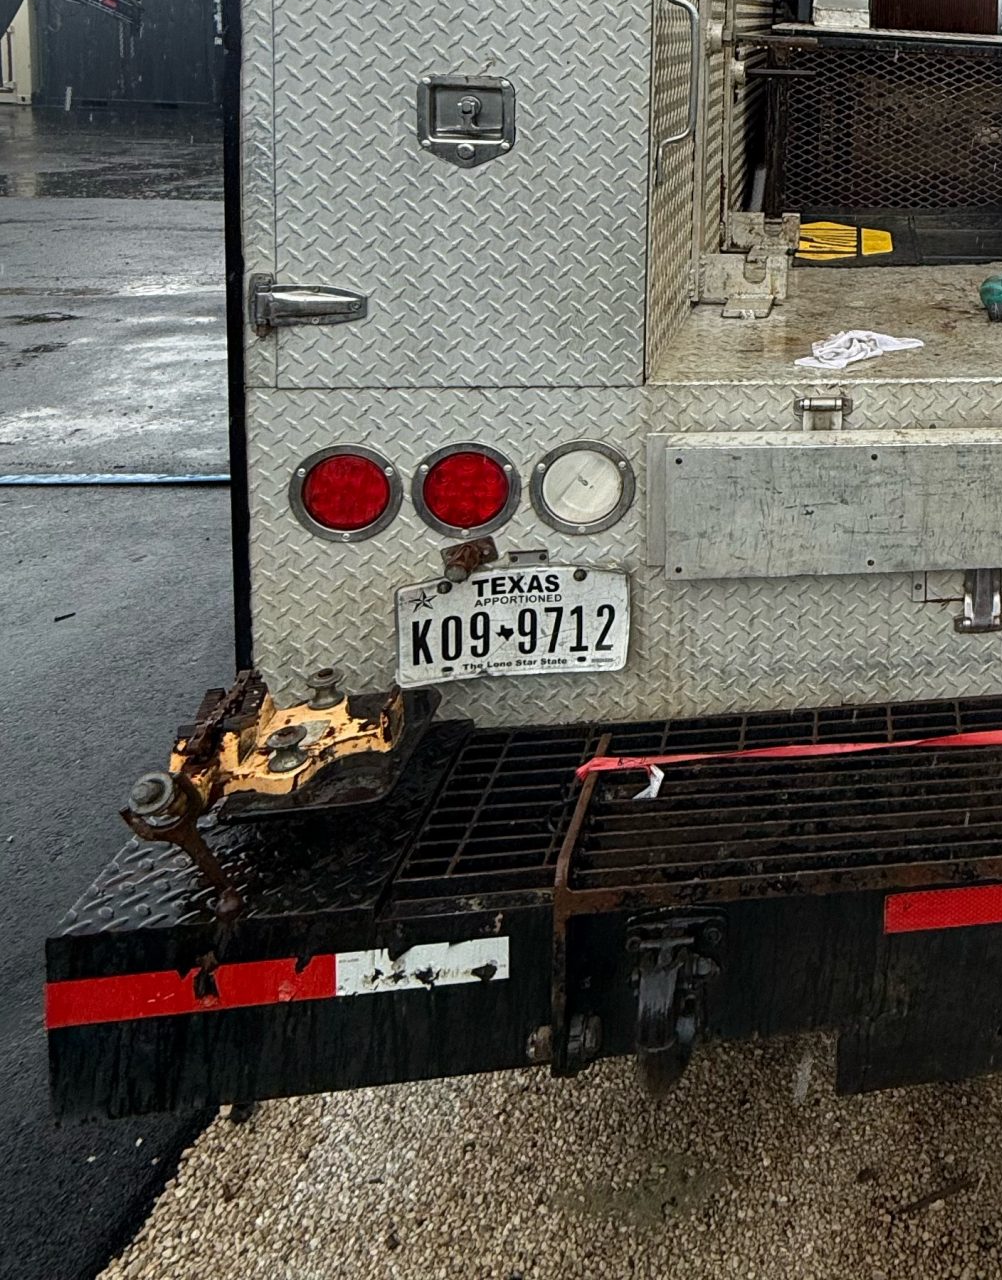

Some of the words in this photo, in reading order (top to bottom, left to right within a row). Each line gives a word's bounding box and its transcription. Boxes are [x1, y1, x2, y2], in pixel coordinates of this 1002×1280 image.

[472, 574, 560, 597] TEXAS
[474, 594, 562, 608] APPORTIONED
[462, 662, 483, 670] The
[487, 660, 512, 668] Lone
[540, 657, 568, 665] State
